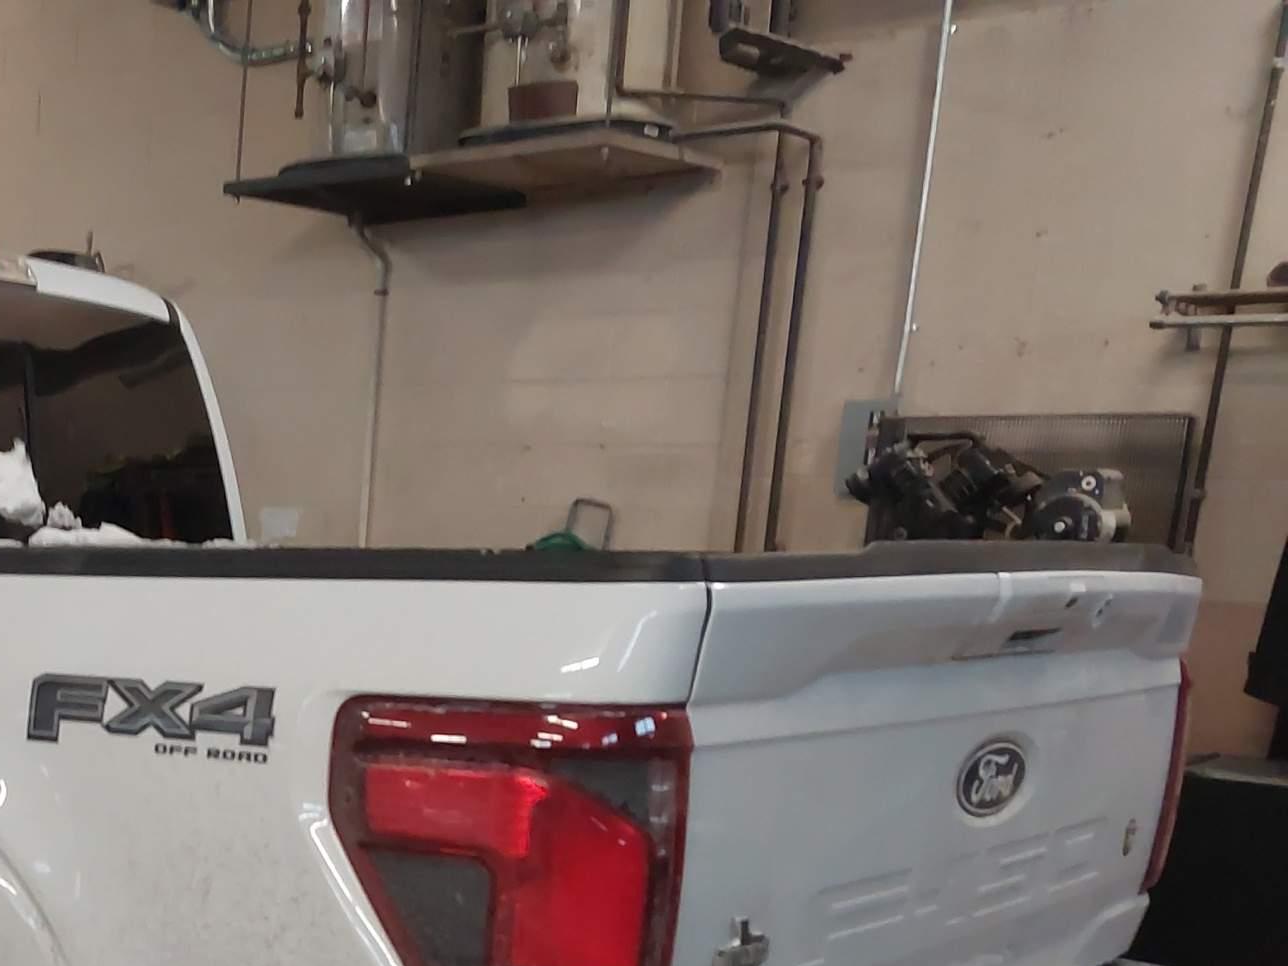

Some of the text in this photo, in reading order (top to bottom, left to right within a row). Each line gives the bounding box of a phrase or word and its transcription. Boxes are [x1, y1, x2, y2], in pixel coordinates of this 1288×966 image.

[26, 673, 276, 747] FX4
[154, 743, 268, 764] OFF ROAD
